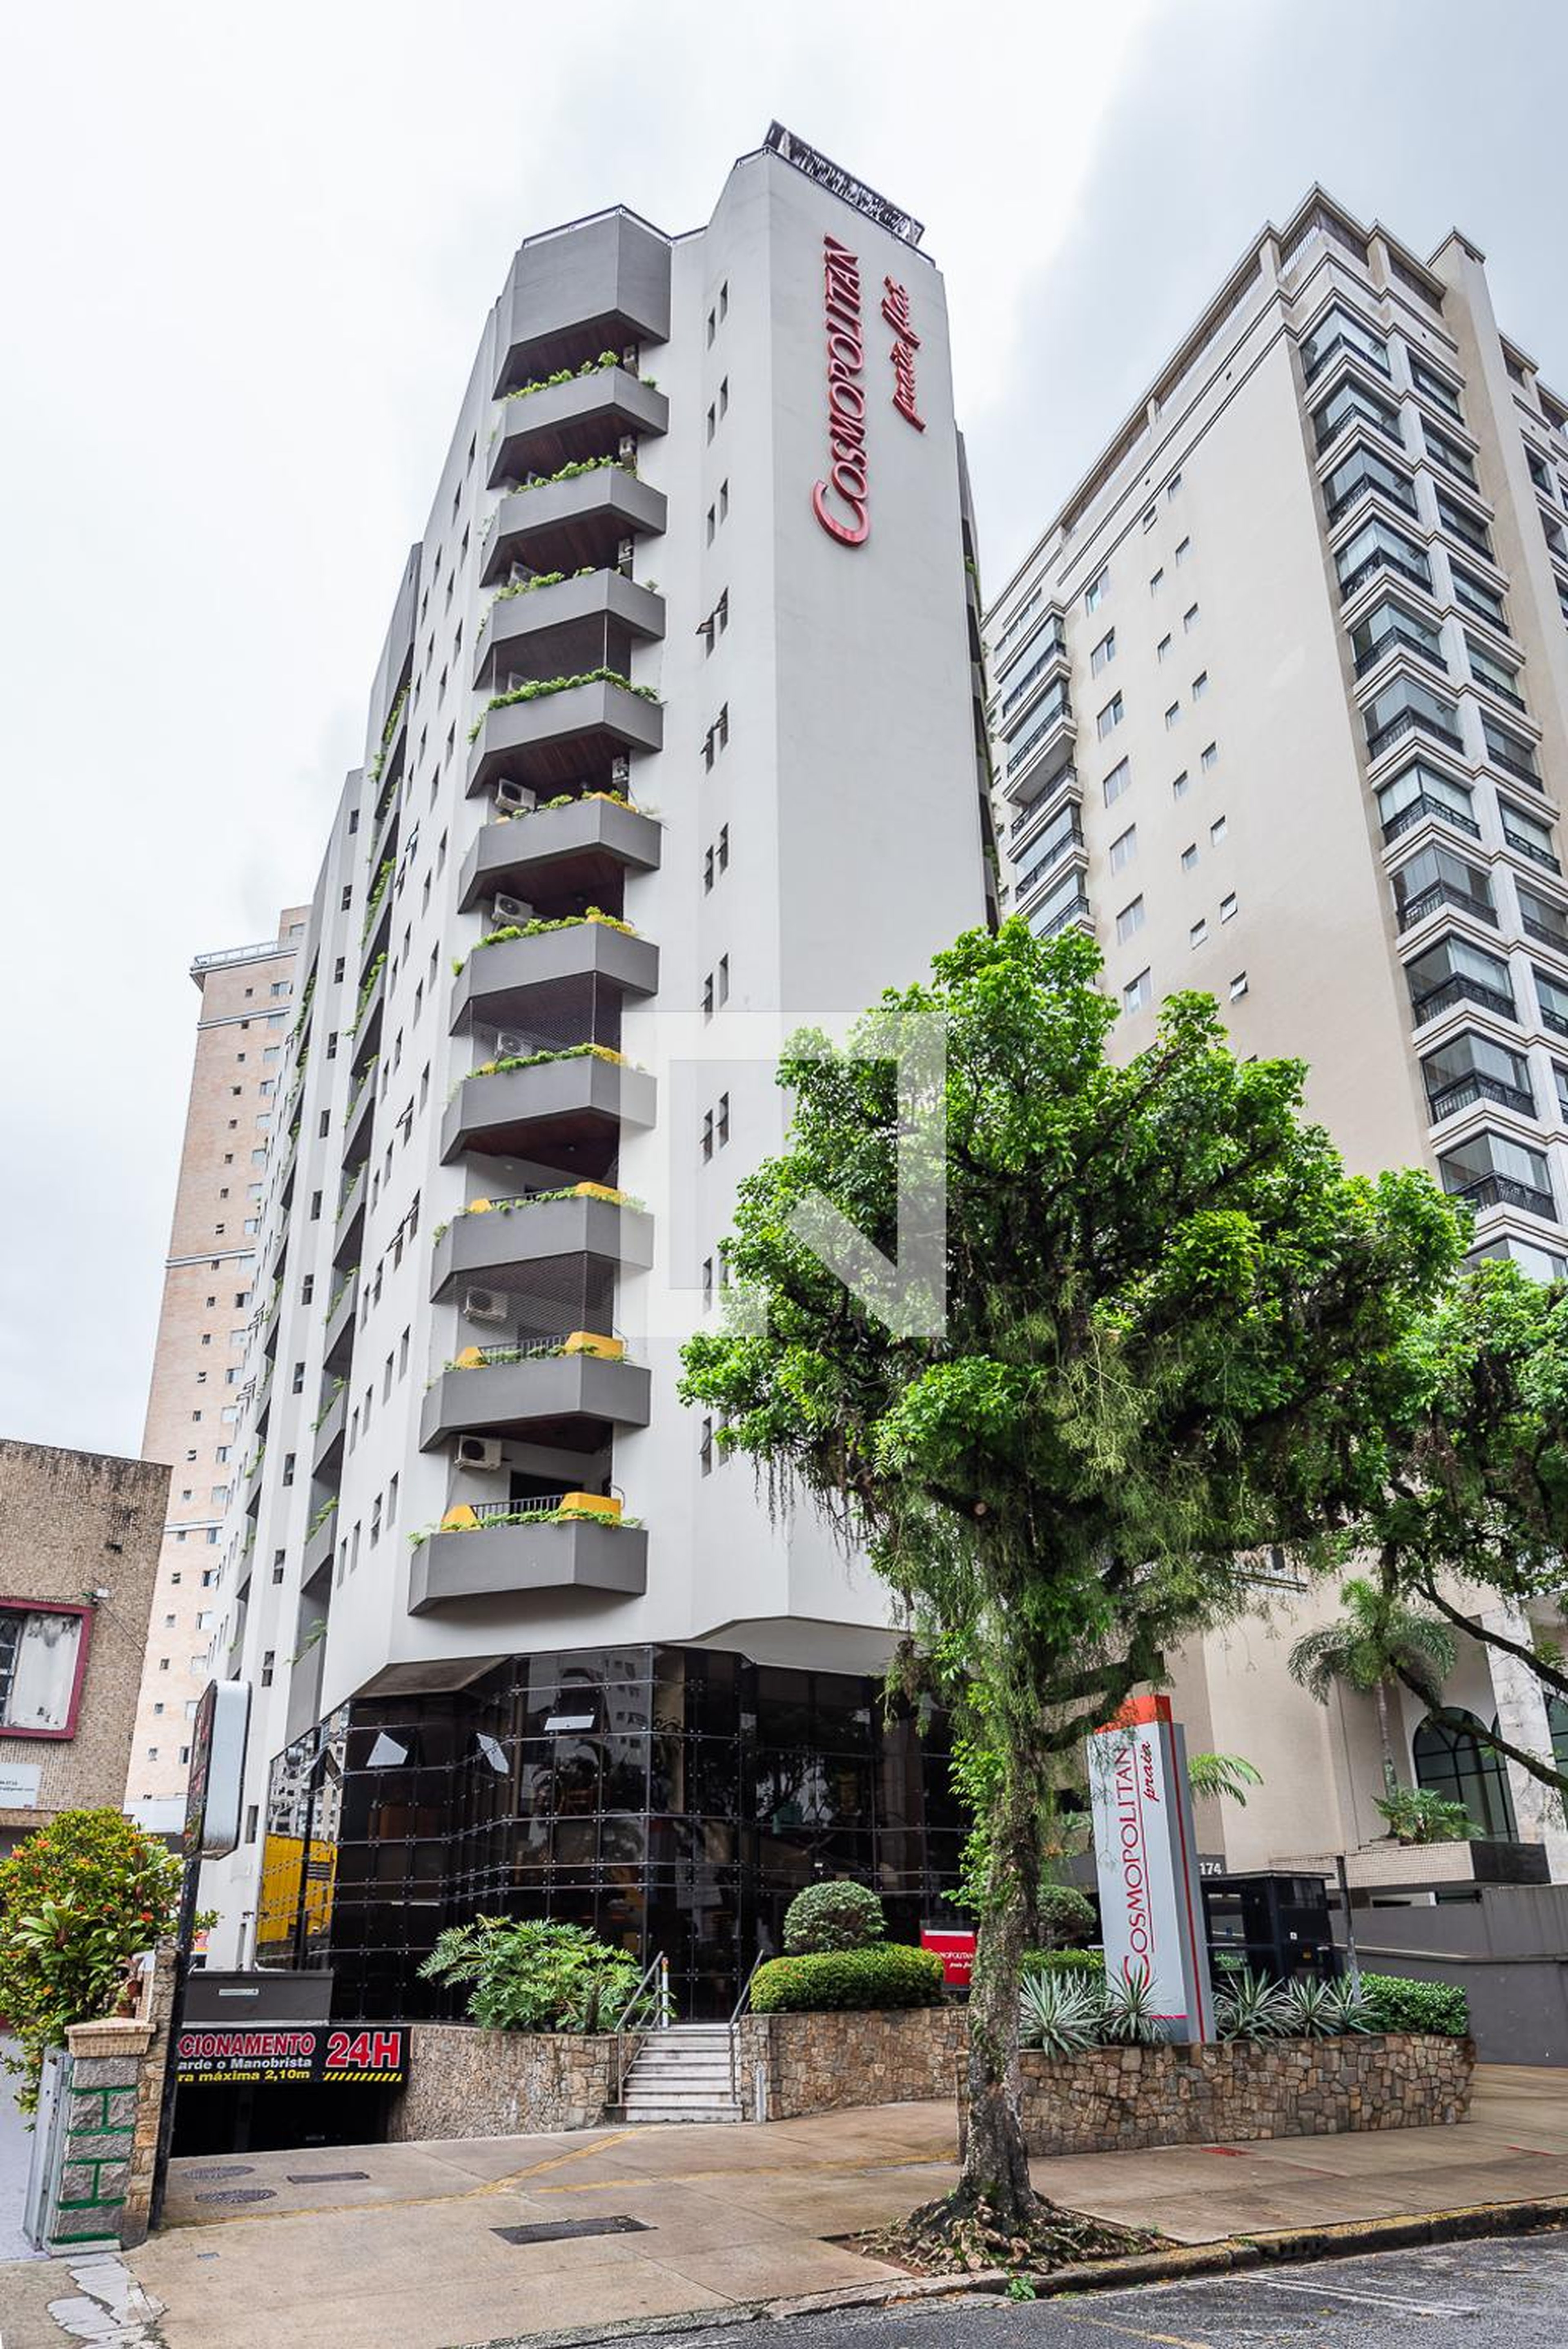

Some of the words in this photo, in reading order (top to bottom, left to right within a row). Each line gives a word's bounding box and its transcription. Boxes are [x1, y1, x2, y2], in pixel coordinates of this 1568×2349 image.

[1140, 1741, 1160, 1802] praia
[1200, 1862, 1222, 1875] 174
[177, 2033, 316, 2058] CIONAMENTO
[325, 2031, 401, 2068] 24H
[177, 2060, 212, 2070] arde
[217, 2061, 225, 2069] o
[230, 2057, 312, 2069] Manobrista
[198, 2070, 260, 2082] máxima
[265, 2069, 310, 2082] 2,10m
